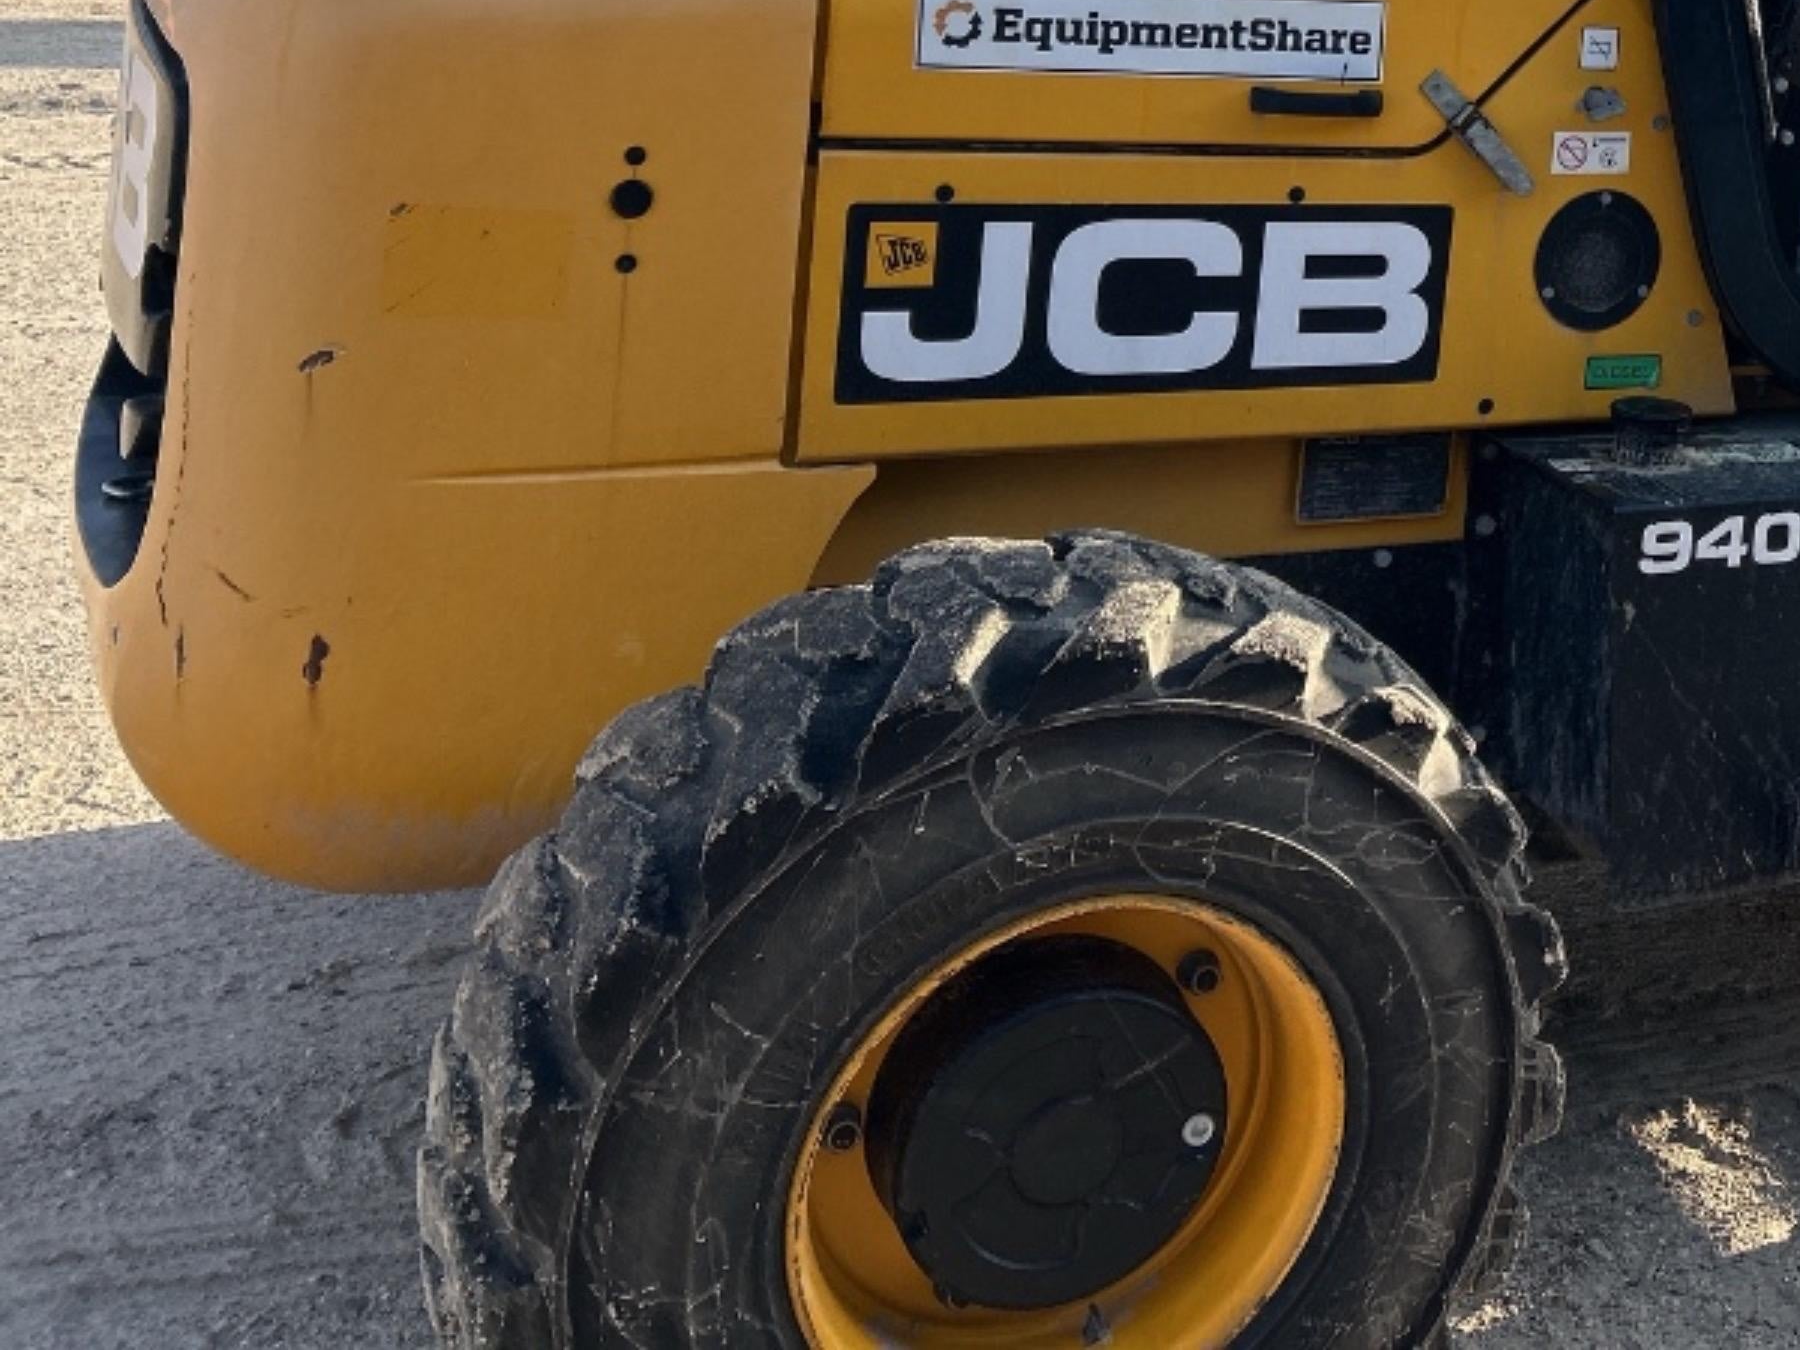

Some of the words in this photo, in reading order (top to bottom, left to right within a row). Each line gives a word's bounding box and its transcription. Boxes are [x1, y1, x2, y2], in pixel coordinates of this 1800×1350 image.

[991, 7, 1373, 57] EquipmentShare
[880, 237, 928, 272] JCB
[860, 217, 1432, 382] JCB
